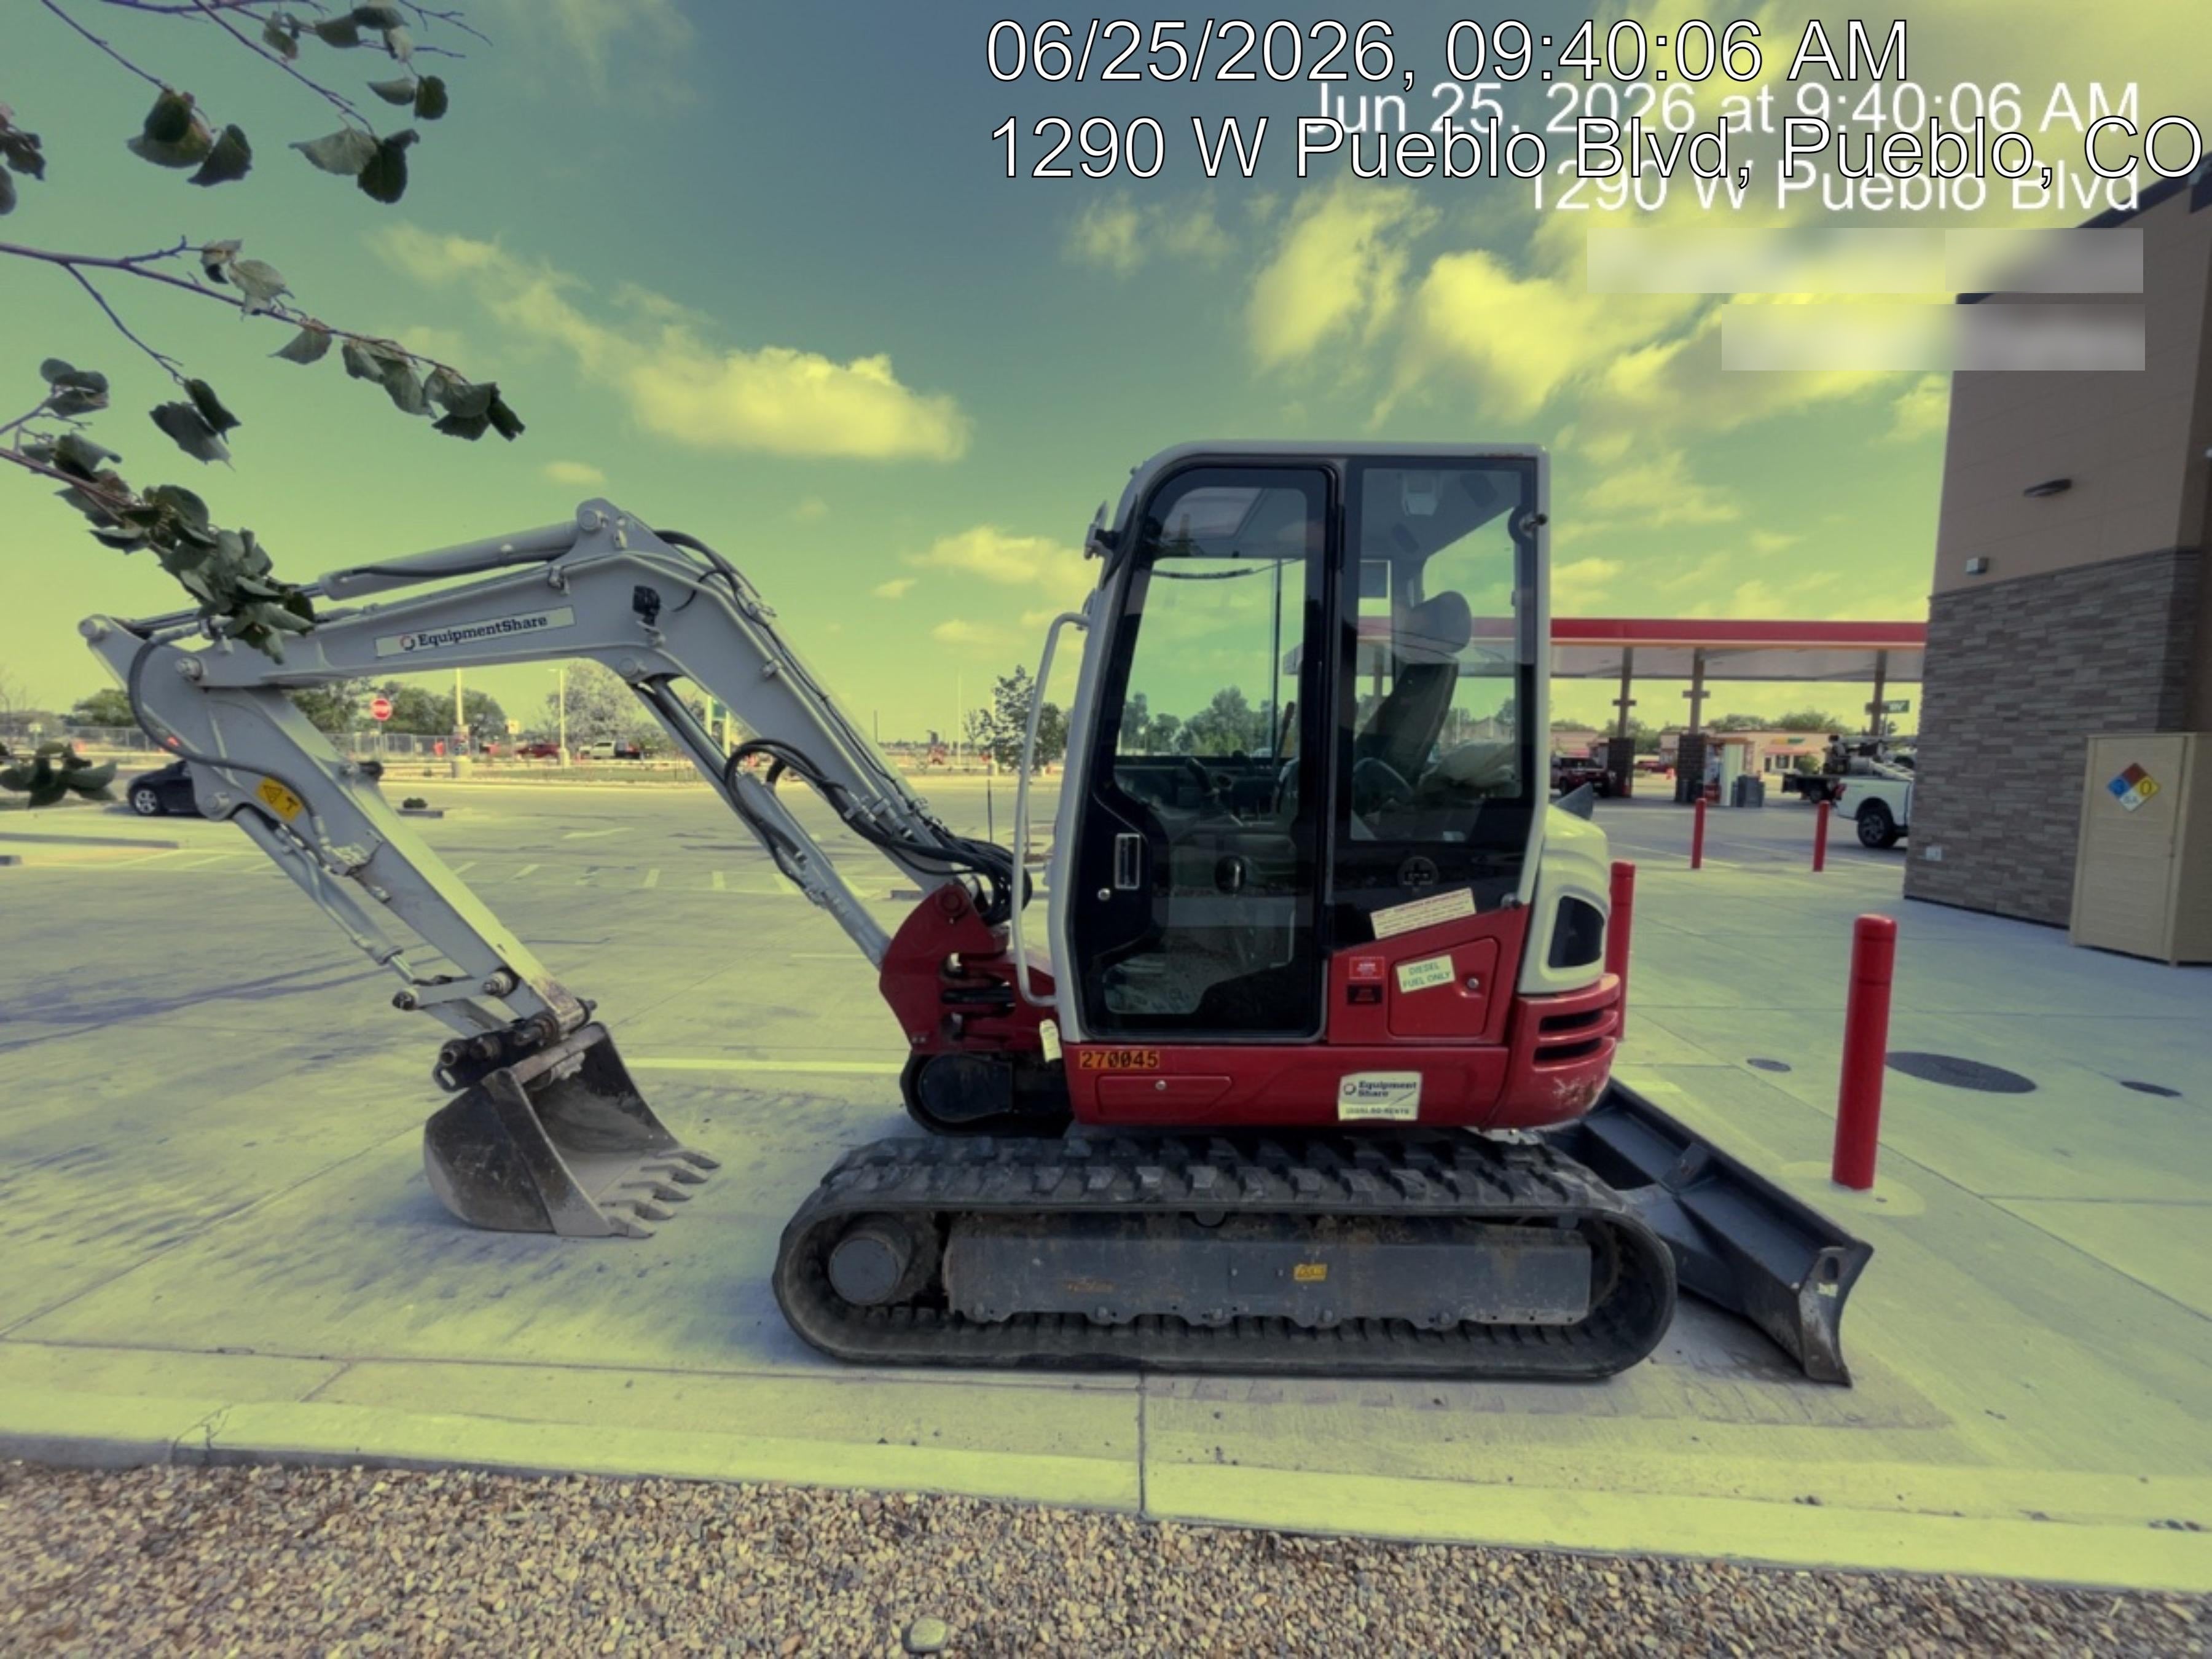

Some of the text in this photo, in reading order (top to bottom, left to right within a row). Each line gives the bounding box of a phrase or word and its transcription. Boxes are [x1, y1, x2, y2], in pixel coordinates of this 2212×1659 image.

[418, 616, 547, 647] EquipmentShare
[1081, 1051, 1158, 1069] 270045
[1358, 1080, 1416, 1090] Equipment
